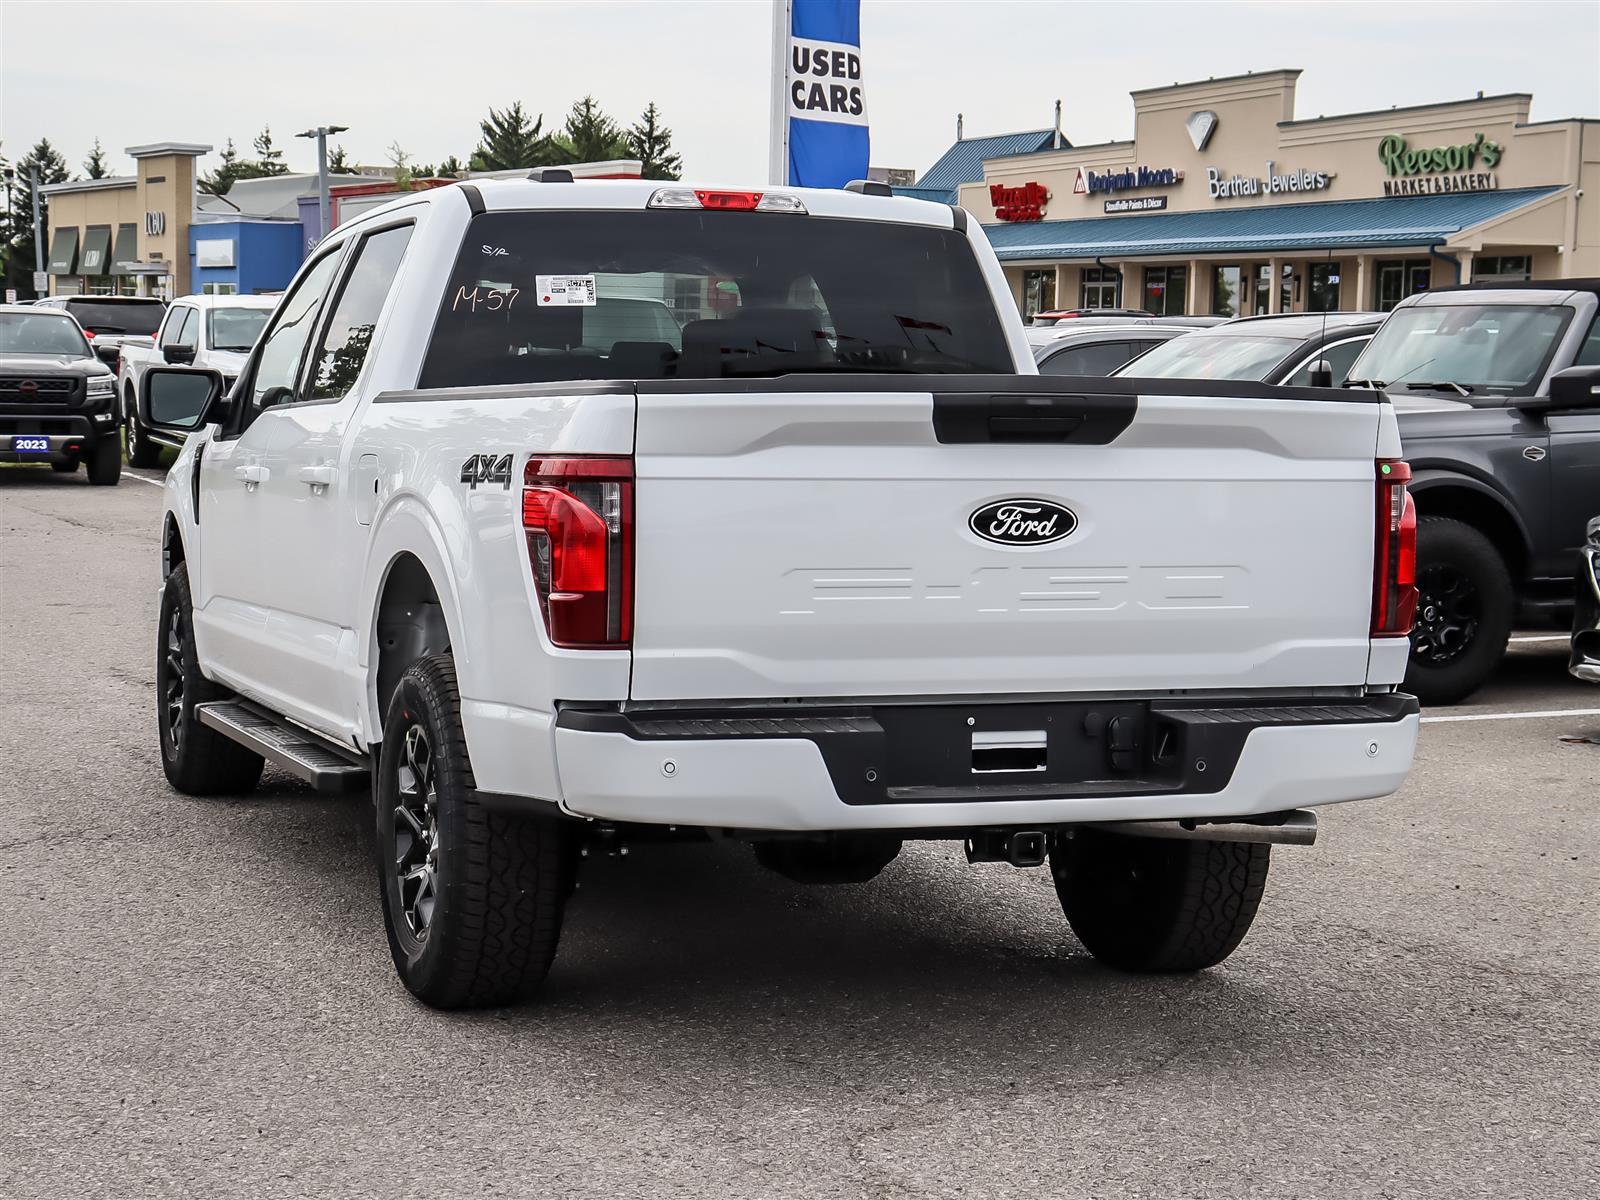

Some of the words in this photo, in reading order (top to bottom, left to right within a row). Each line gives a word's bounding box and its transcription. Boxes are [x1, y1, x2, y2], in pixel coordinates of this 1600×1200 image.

[792, 45, 861, 80] USED
[791, 80, 863, 116] CARS
[1378, 133, 1502, 176] Reesor's
[1207, 167, 1258, 199] Barthau
[1262, 160, 1327, 194] Jewellers
[15, 439, 48, 450] 2023
[990, 506, 1058, 537] Ford
